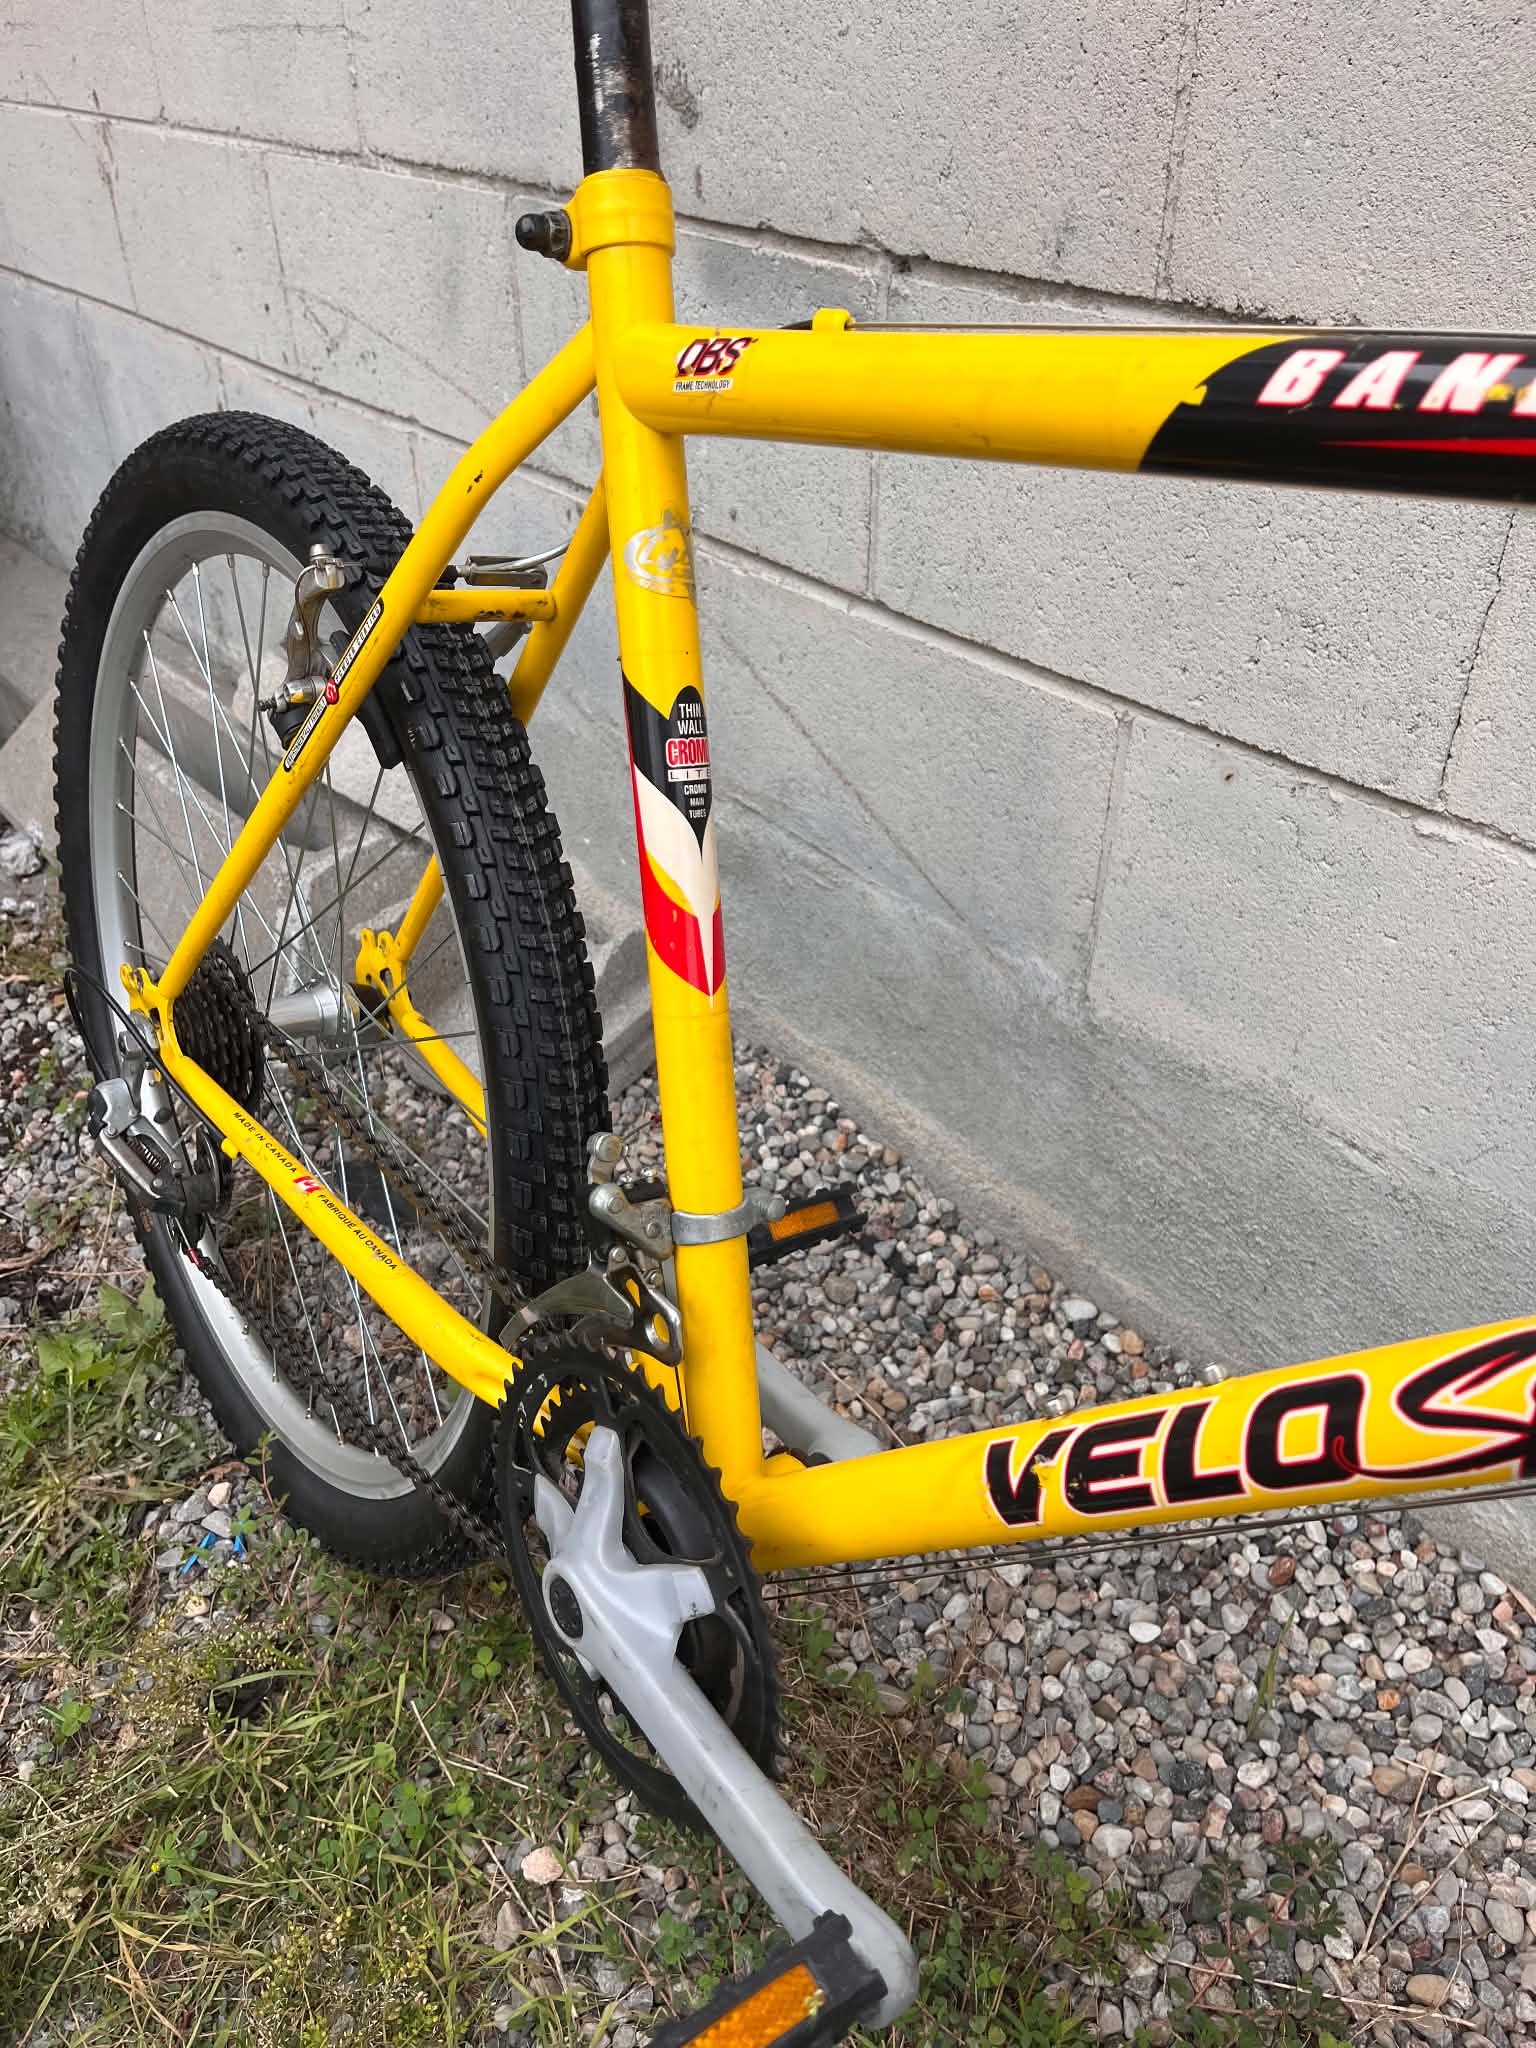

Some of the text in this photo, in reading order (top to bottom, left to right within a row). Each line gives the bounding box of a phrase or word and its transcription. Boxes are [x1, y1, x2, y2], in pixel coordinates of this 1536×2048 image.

[675, 379, 731, 391] FRAME TECHNOLOGY
[1256, 348, 1536, 418] BAN
[678, 703, 702, 718] THIN
[677, 719, 705, 735] WALL
[688, 808, 707, 819] TUBES
[233, 1112, 297, 1173] MADE IN CANADA
[353, 1229, 367, 1241] AU
[364, 1239, 398, 1271] CANADA
